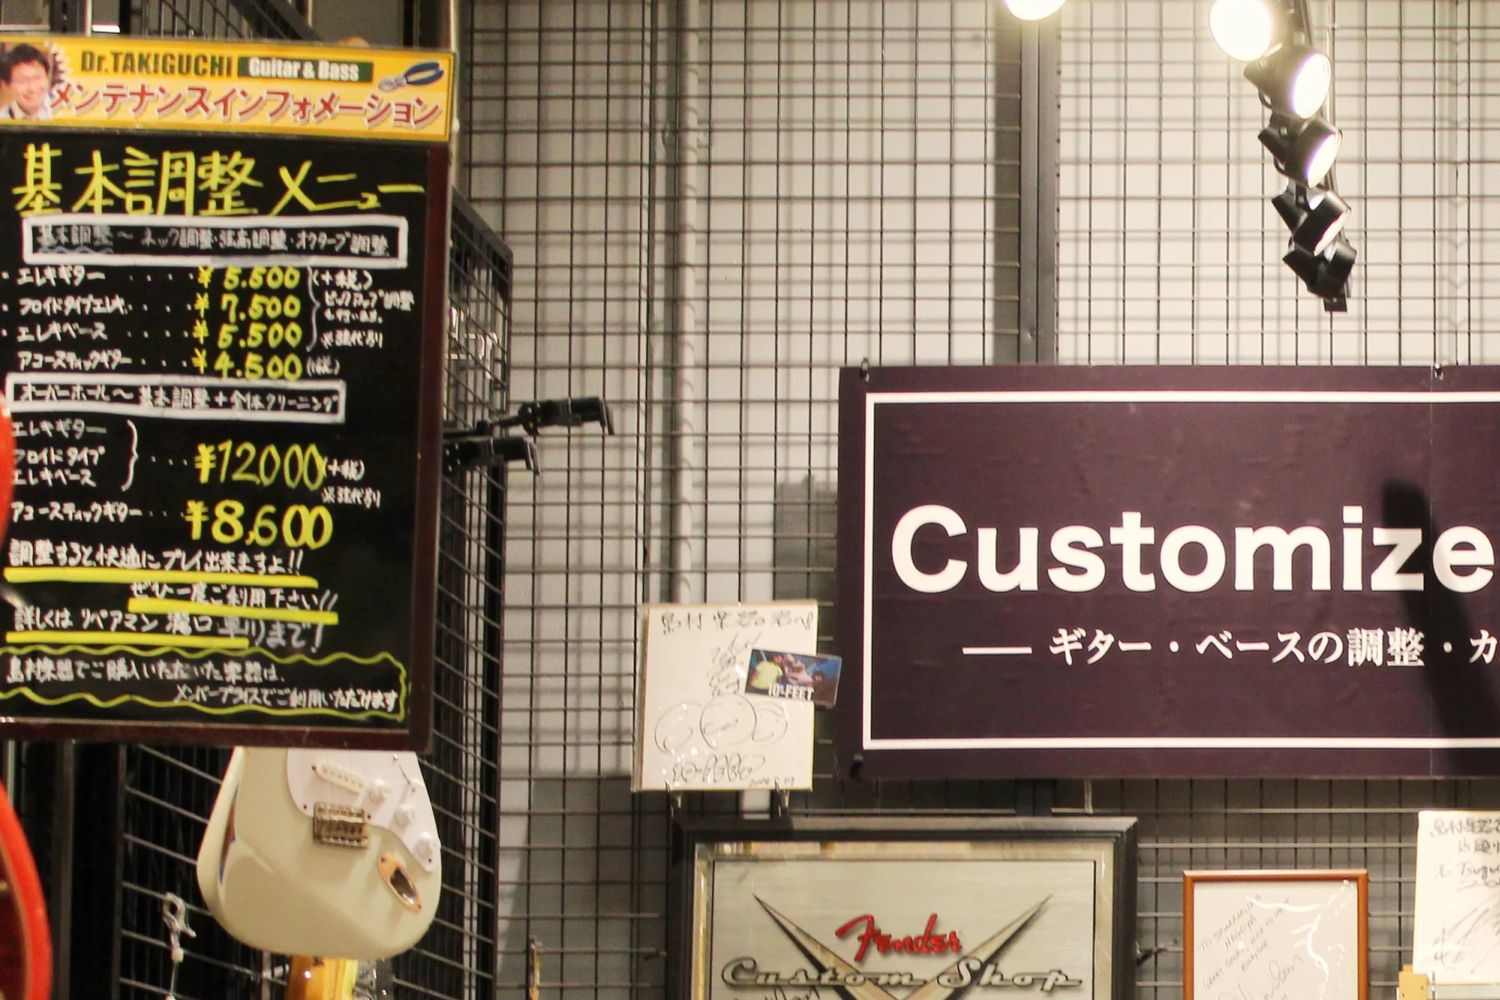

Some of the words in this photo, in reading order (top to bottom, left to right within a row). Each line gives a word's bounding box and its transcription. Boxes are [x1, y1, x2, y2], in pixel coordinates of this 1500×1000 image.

[81, 52, 233, 78] Dr.TAKIGUCHI
[248, 58, 302, 80] Guitar
[317, 62, 360, 82] Bass
[50, 83, 441, 128] メンテナンスインフォメーション
[891, 504, 1495, 595] Customize
[835, 912, 963, 963] Fender
[720, 956, 930, 989] Custom
[937, 956, 1084, 993] Shop
